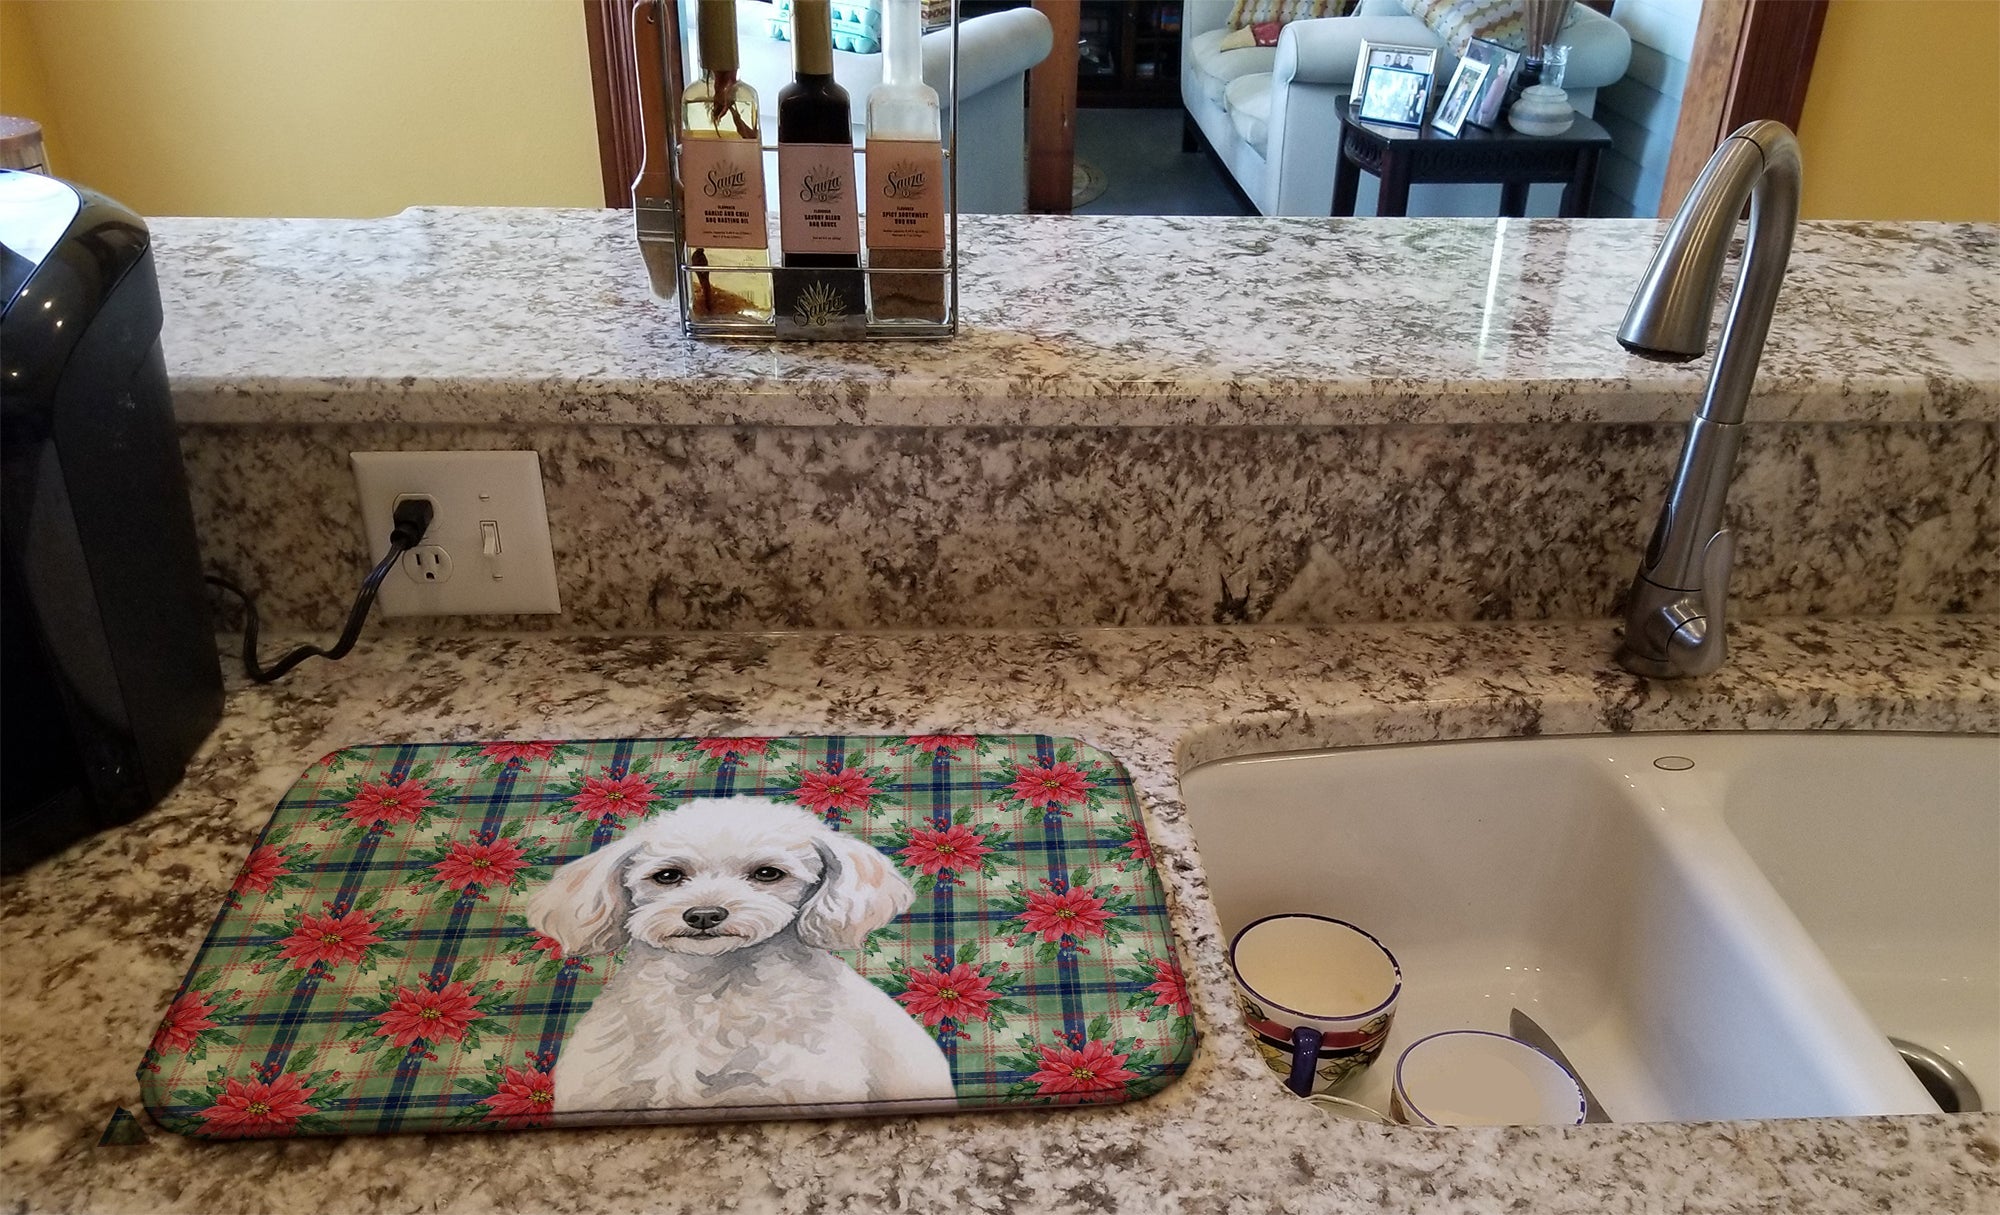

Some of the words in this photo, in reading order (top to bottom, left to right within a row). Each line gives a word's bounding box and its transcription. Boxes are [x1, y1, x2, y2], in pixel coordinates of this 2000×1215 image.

[704, 169, 746, 197] Sauza
[800, 175, 842, 202] Sauza
[883, 170, 926, 198] Sauza
